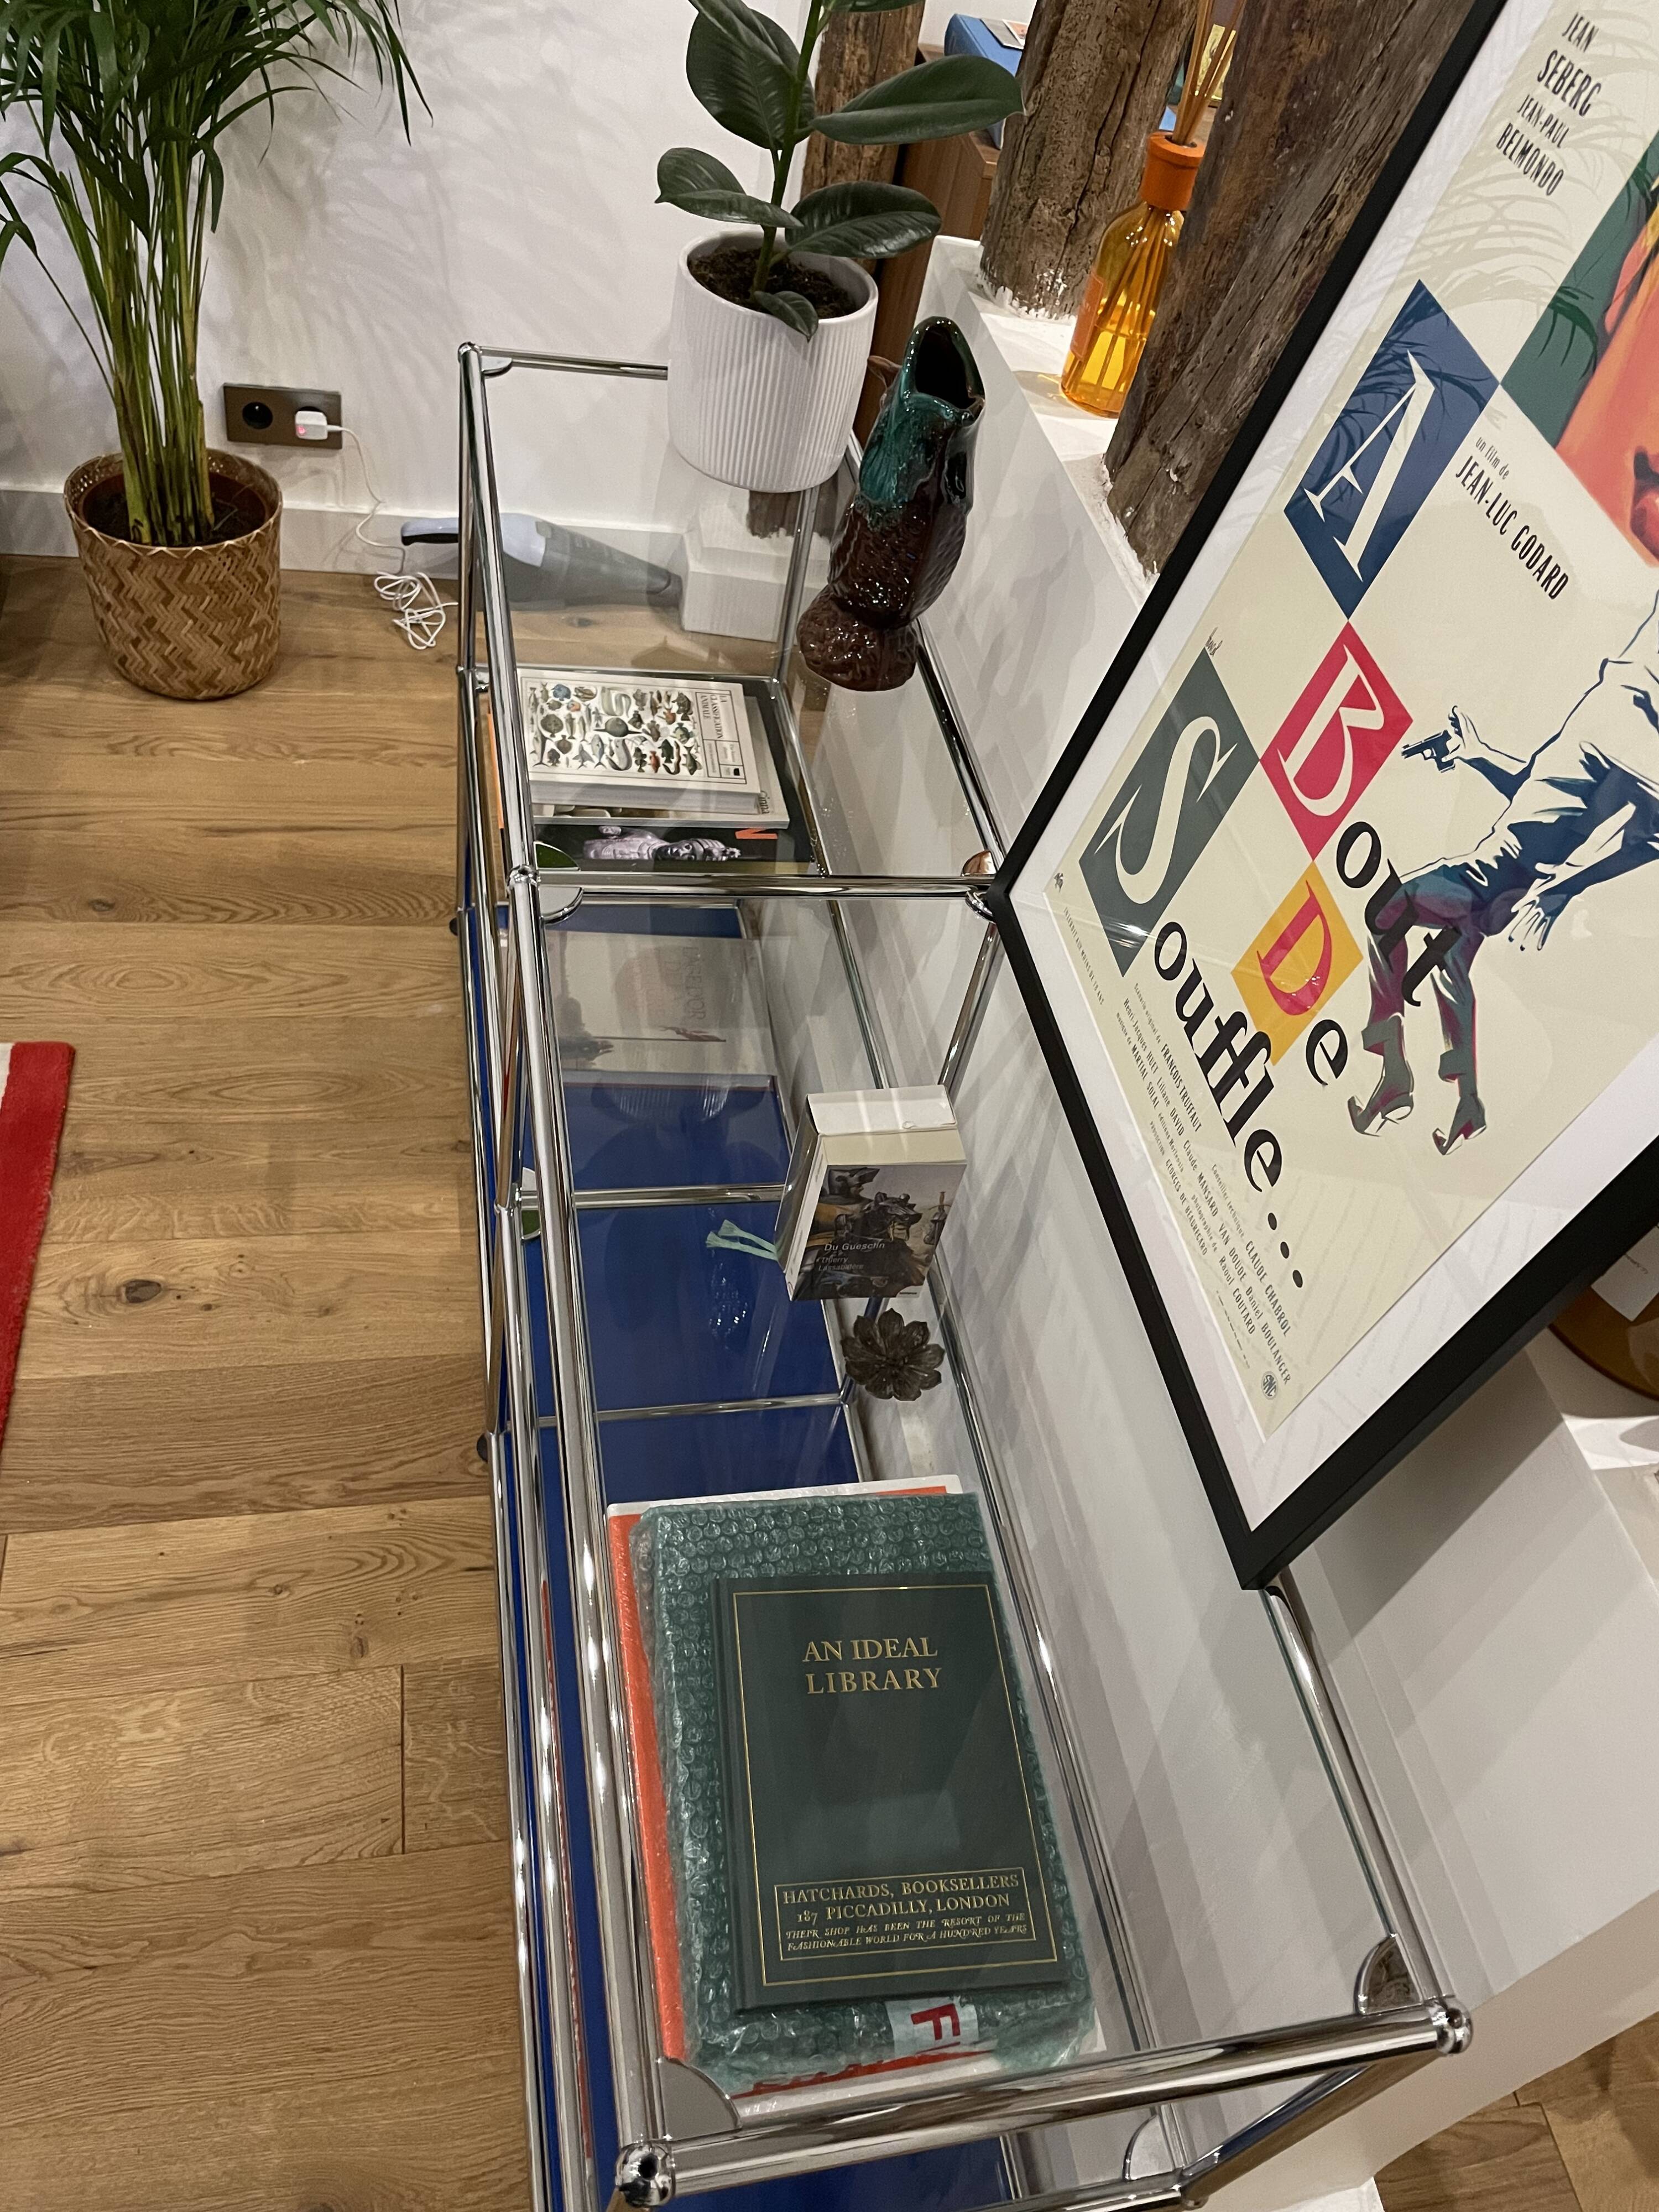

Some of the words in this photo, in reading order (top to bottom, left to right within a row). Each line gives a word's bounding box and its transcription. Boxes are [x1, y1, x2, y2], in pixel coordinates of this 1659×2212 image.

[1562, 12, 1599, 53] JEAN
[1537, 49, 1601, 117] SEBERG
[1517, 94, 1569, 148] JEAN-PAUL
[1496, 122, 1564, 196] BELMONDO
[1303, 350, 1436, 582] A
[1475, 436, 1486, 452] un
[1485, 445, 1500, 469] film
[1499, 463, 1510, 479] de
[1455, 455, 1517, 535] JEAN-LUC
[1511, 525, 1569, 599] GODARD
[1179, 1085, 1202, 1132] TRUFFAUT
[1131, 1044, 1149, 1081] MARTIAL
[1146, 1081, 1160, 1110] SOLAL
[1219, 1256, 1235, 1286] Raoul
[1232, 1287, 1256, 1335] COUTARD
[1165, 1159, 1181, 1192] GEORGES
[1180, 1192, 1187, 1206] DE
[1185, 1205, 1208, 1255] BEAUREGARD
[1146, 1051, 1159, 1074] HUET
[1156, 1077, 1171, 1107] Liliane
[1170, 1108, 1185, 1136] DAVID
[1183, 1140, 1198, 1171] Claude
[1197, 1172, 1219, 1217] MANSARD
[1218, 1222, 1230, 1246] VAN
[1229, 1246, 1248, 1283] DOUDE
[1245, 1286, 1262, 1320] Daniel
[1261, 1322, 1291, 1385] BOULANGER
[842, 1243, 885, 1251] Guesclin
[1245, 1240, 1268, 1284] CLAUDE
[1265, 1284, 1291, 1337] CHABROL
[802, 1640, 843, 1662] AN
[850, 1637, 938, 1660] IDEAL
[805, 1667, 942, 1694] LIBRARY
[782, 1883, 894, 1904] HATCHARDS,
[901, 1874, 1019, 1896] BOOKSELLERS
[796, 1910, 818, 1926] 187
[826, 1899, 933, 1920] PICCADILLY,
[935, 1893, 1009, 1912] LONDON
[786, 1929, 821, 1939] THEIR
[825, 1927, 850, 1936] SHOP
[855, 1924, 878, 1934] HAS
[885, 1922, 910, 1932] BEEN
[916, 1919, 936, 1929] THE
[941, 1916, 982, 1928] RESORT
[987, 1914, 1000, 1923] OF
[1005, 1912, 1025, 1922] THE
[787, 1936, 862, 1951] FASHIONABLE
[865, 1934, 900, 1945] WORLD
[902, 1933, 927, 1942] FOR
[926, 1931, 936, 1940] A
[940, 1928, 991, 1939] HUNDRED
[994, 1924, 1027, 1934] YEARS
